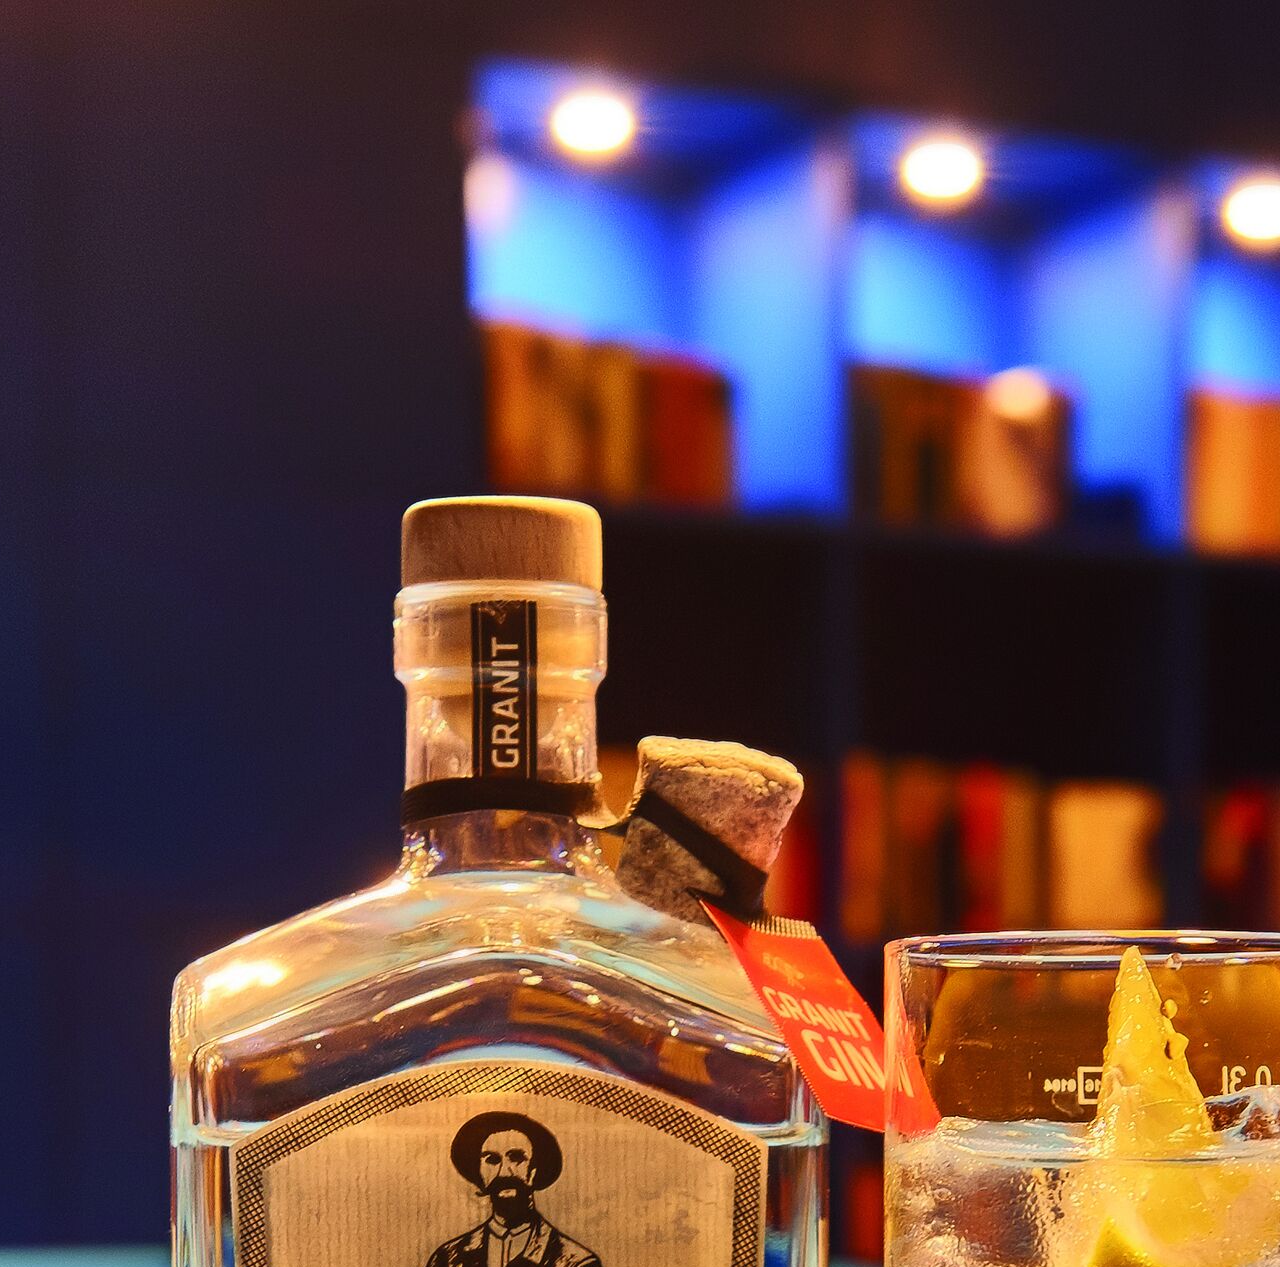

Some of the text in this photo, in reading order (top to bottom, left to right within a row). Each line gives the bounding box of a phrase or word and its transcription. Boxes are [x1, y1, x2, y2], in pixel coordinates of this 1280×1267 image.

[490, 636, 520, 769] GRANIT
[761, 985, 872, 1042] GRANIT
[800, 1028, 915, 1099] GIN
